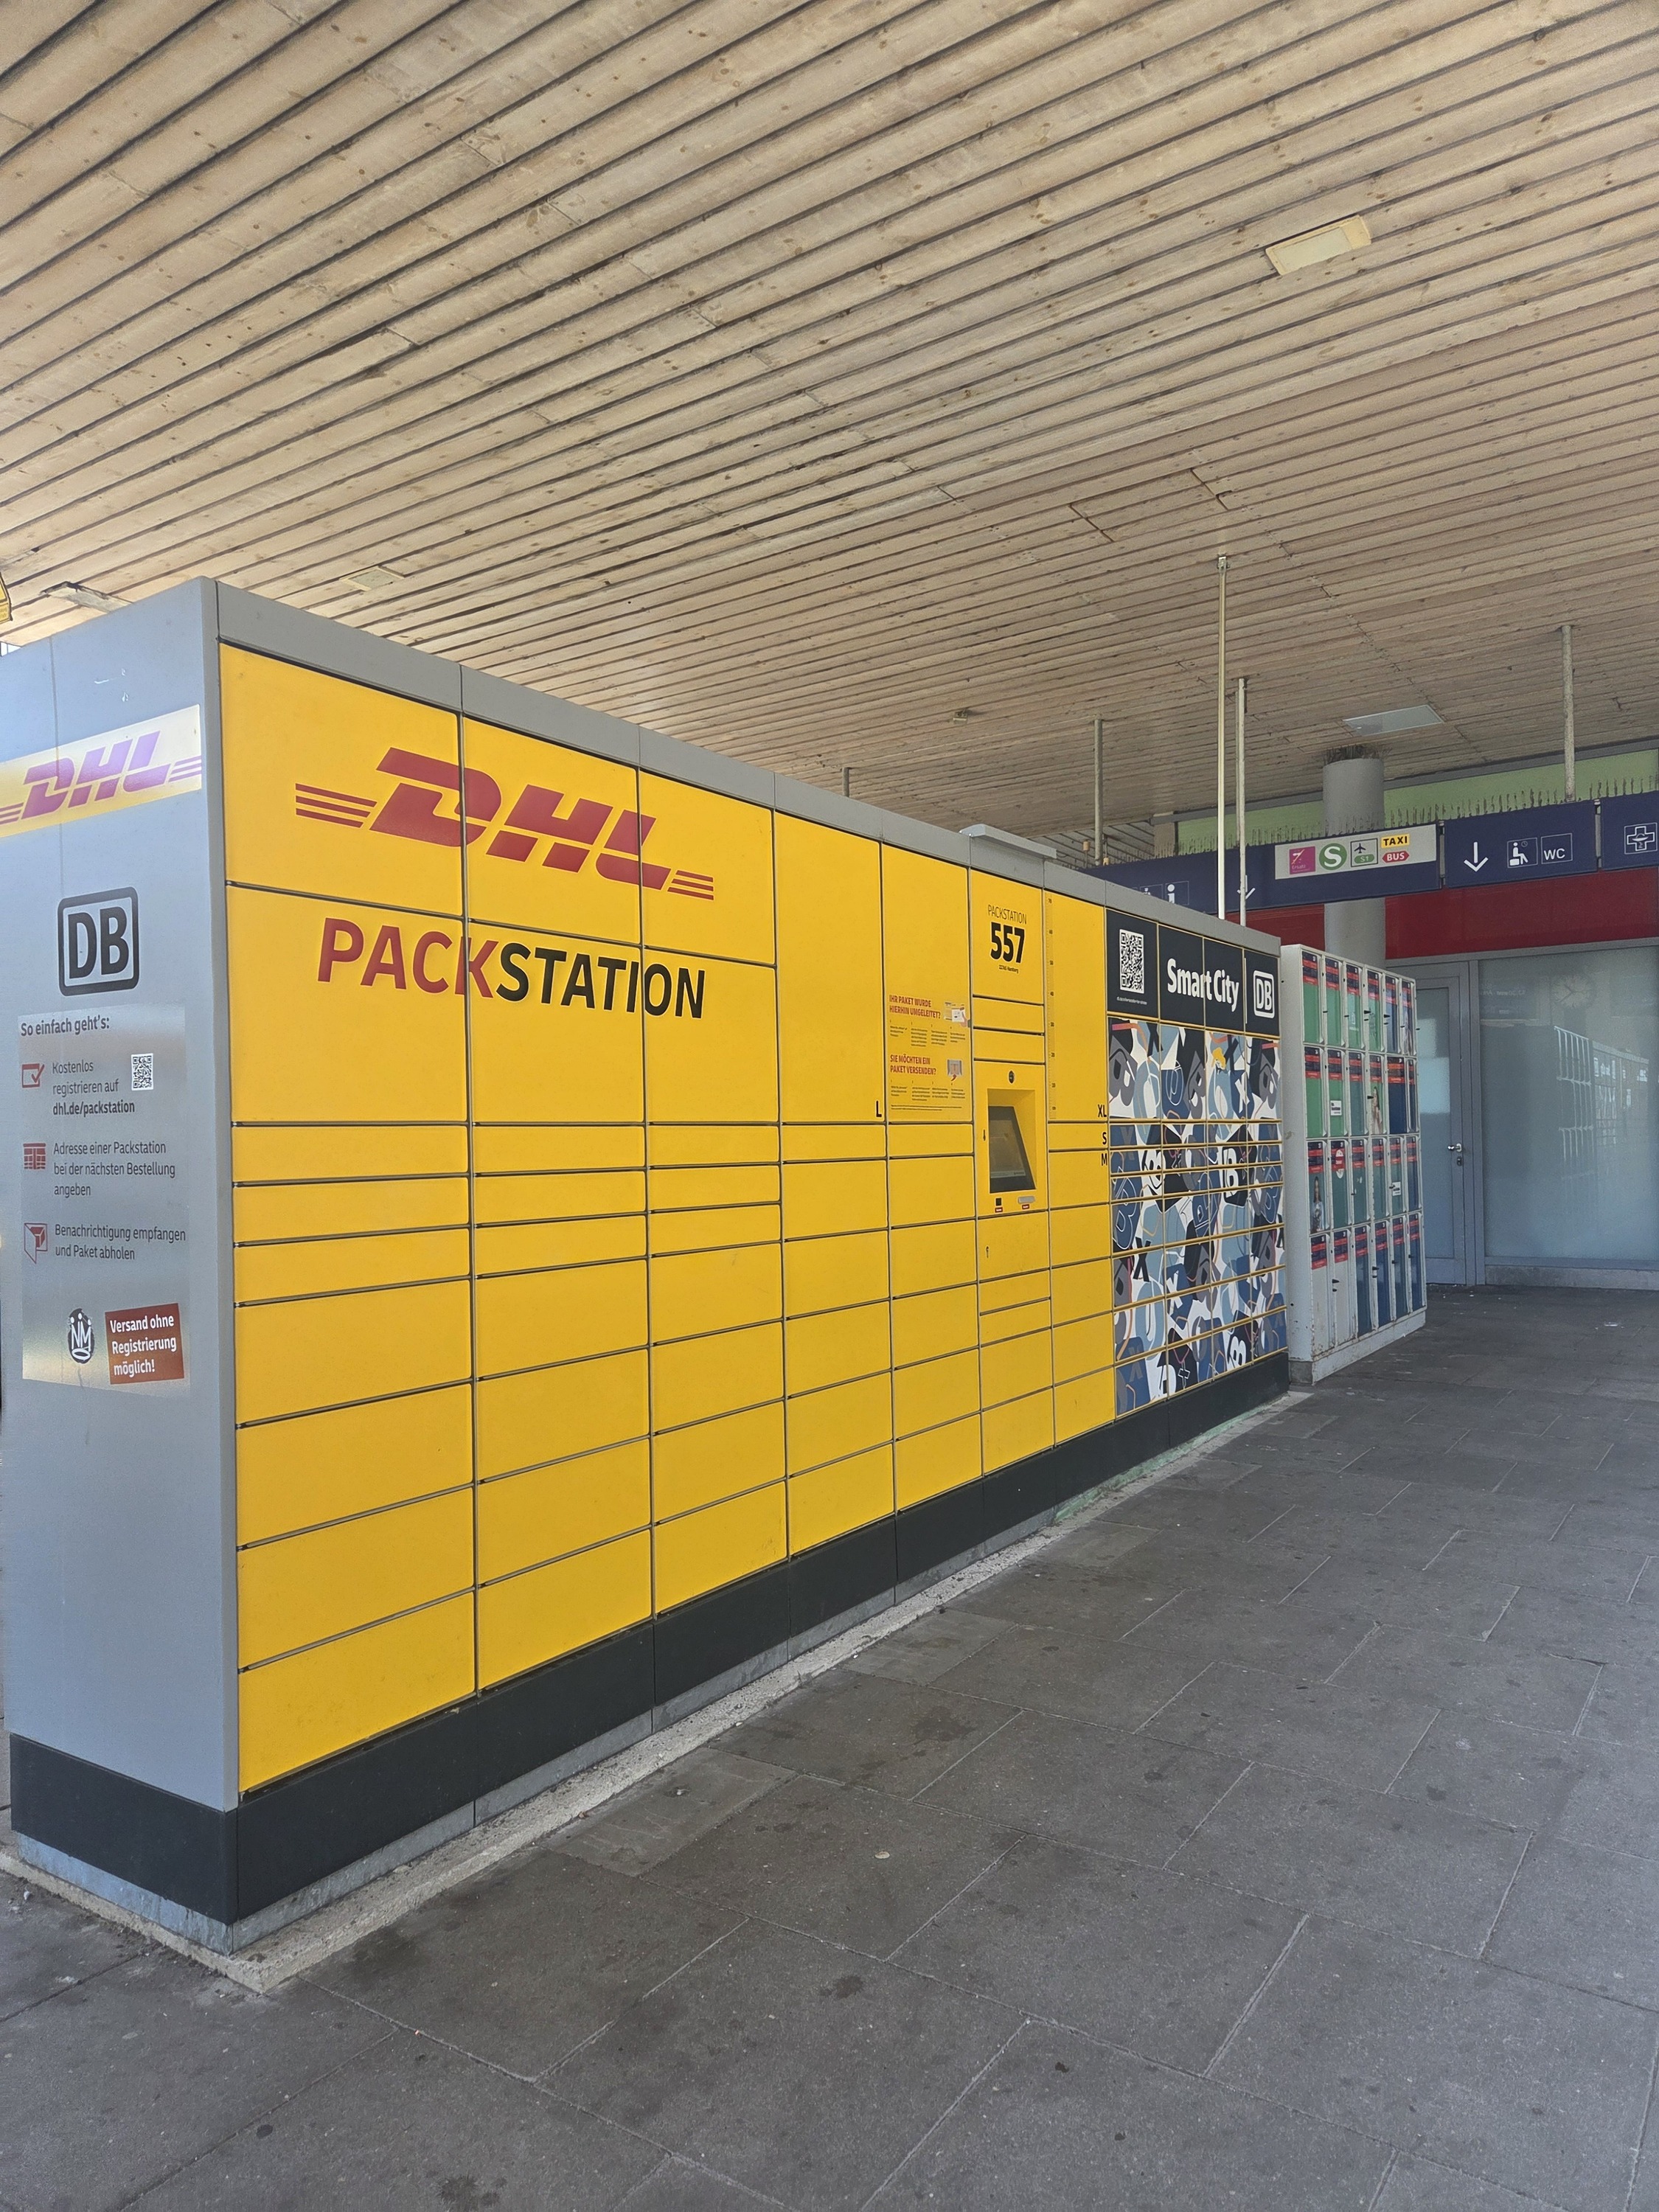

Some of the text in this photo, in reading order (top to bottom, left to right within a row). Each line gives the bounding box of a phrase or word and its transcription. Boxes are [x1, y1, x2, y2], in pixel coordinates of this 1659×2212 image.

[21, 731, 171, 820] DHL
[369, 747, 671, 890] DHL
[1382, 835, 1408, 846] TAXI
[1386, 852, 1405, 862] BUS
[1544, 849, 1565, 860] WC
[987, 904, 1027, 925] PACKSTATION
[67, 906, 129, 979] DB
[990, 921, 1025, 964] 557
[318, 917, 705, 1019] PACKSTATION
[1167, 959, 1239, 1012] Smart City
[889, 995, 931, 1008] IHR PAKET WURDE
[1256, 978, 1273, 1011] DB
[889, 1005, 941, 1019] HIERHIN UMGELEITET?
[21, 1023, 33, 1036] So
[36, 1018, 72, 1034] einfach
[52, 1059, 94, 1074] Kostenlos
[890, 1054, 898, 1062] SIE
[899, 1054, 922, 1065] MÖCHTEN
[890, 1065, 936, 1075] PAKET VERSENDEN?
[52, 1079, 119, 1098] registrieren auf
[52, 1099, 135, 1118] dhl.de/packstation
[875, 1101, 883, 1118] L
[1097, 1104, 1107, 1118] XL
[1102, 1132, 1107, 1145] S
[53, 1141, 167, 1155] Adresse einer Packstation
[1101, 1153, 1107, 1166] M
[54, 1161, 175, 1178] bei der nächsten Bestellung
[54, 1183, 91, 1198] angeben
[55, 1224, 186, 1244] Benachrichtigung empfangen
[55, 1245, 135, 1260] und Paket abholen
[110, 1314, 174, 1333] Versand ohne
[111, 1337, 177, 1357] Registrierung
[114, 1359, 155, 1377] möglich!
